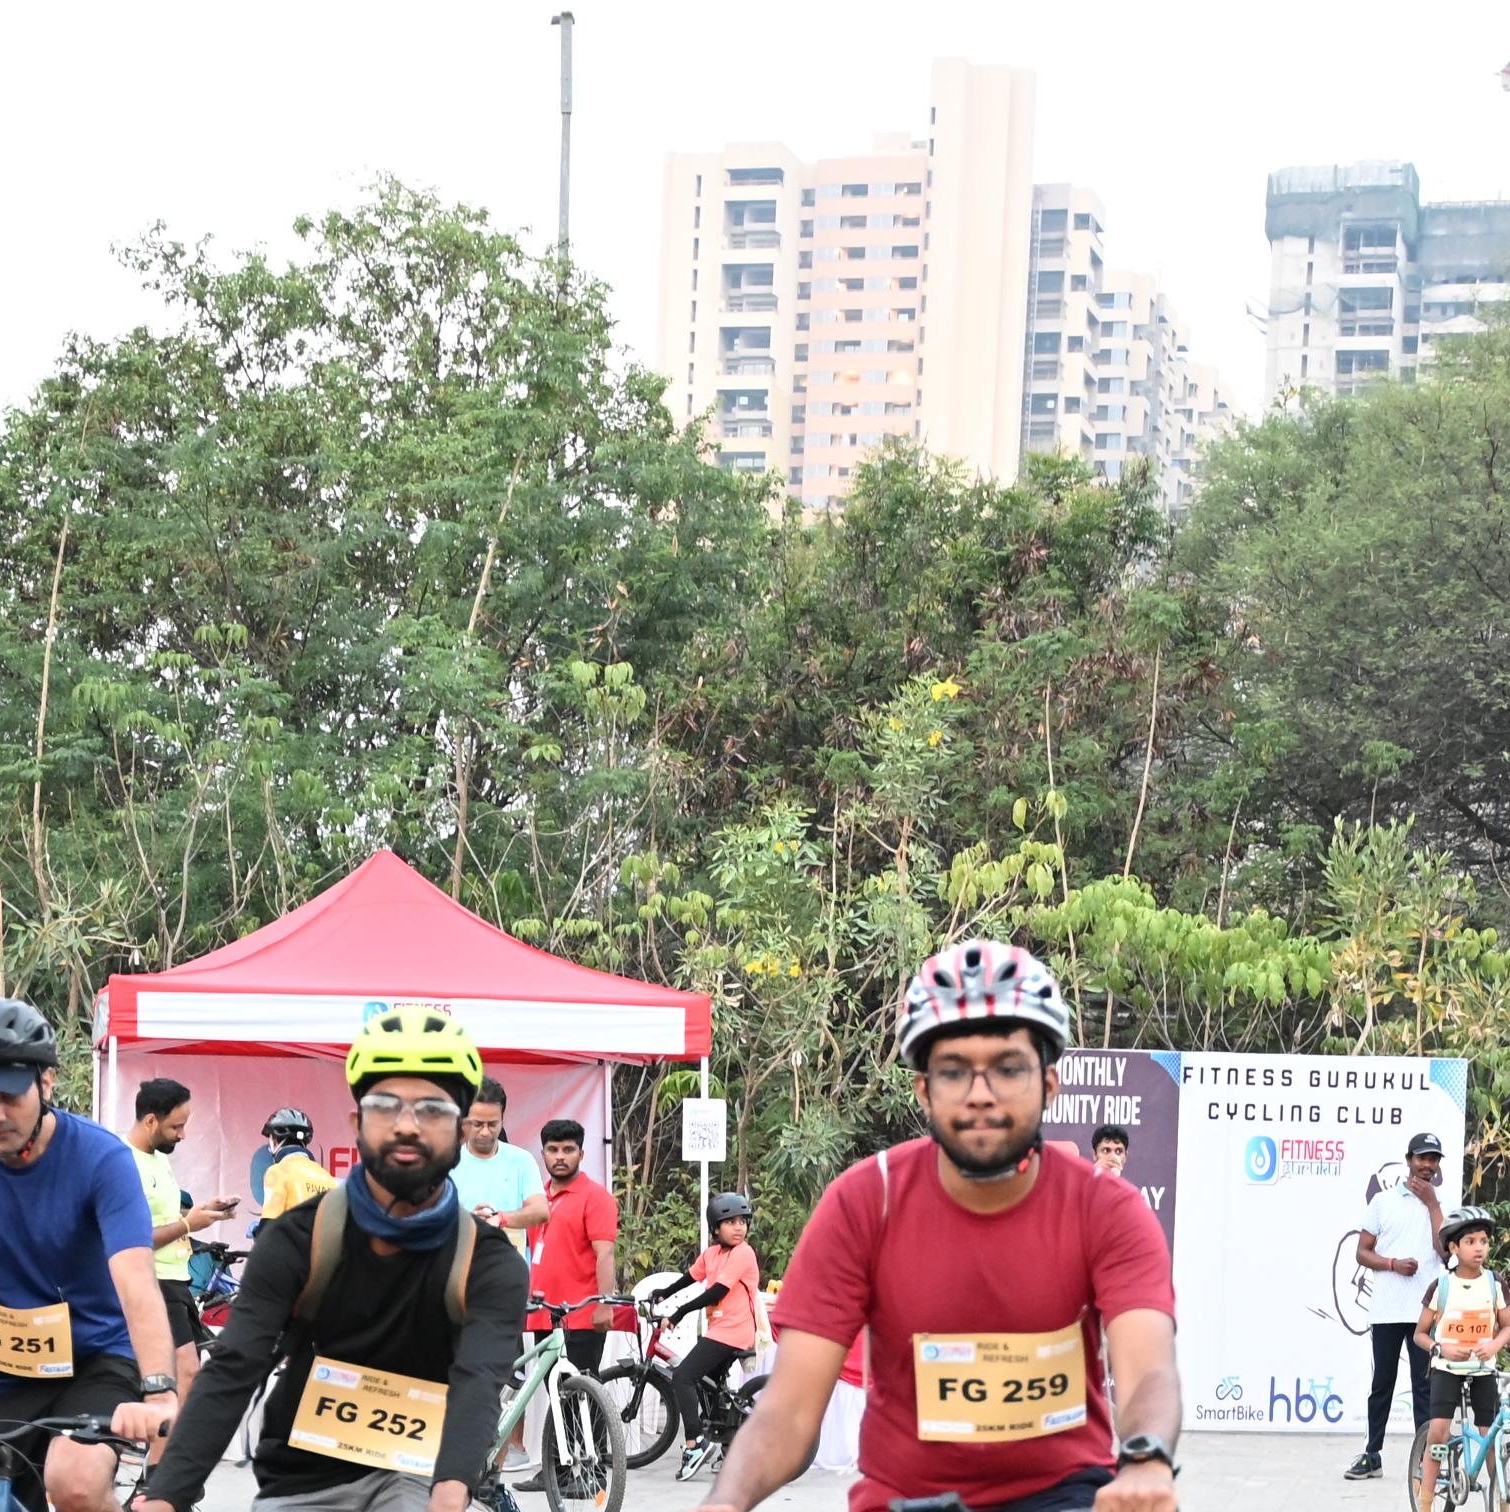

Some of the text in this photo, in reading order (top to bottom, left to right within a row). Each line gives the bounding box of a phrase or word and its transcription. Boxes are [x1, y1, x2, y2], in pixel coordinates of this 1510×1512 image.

[1183, 1066, 1430, 1091] FITNESS GURUKUL
[1104, 1096, 1141, 1125] RIDE
[1208, 1102, 1403, 1125] CYCLING CLUB
[1281, 1139, 1344, 1161] FITNESS
[1448, 1323, 1487, 1334] FG 107
[10, 1336, 55, 1354] 251
[361, 1374, 380, 1384] RIDE
[938, 1373, 1069, 1403] FG 259
[363, 1385, 401, 1398] REFRESH
[1269, 1376, 1344, 1423] hbc
[315, 1396, 427, 1441] FG 252
[1196, 1405, 1264, 1421] SmartBike
